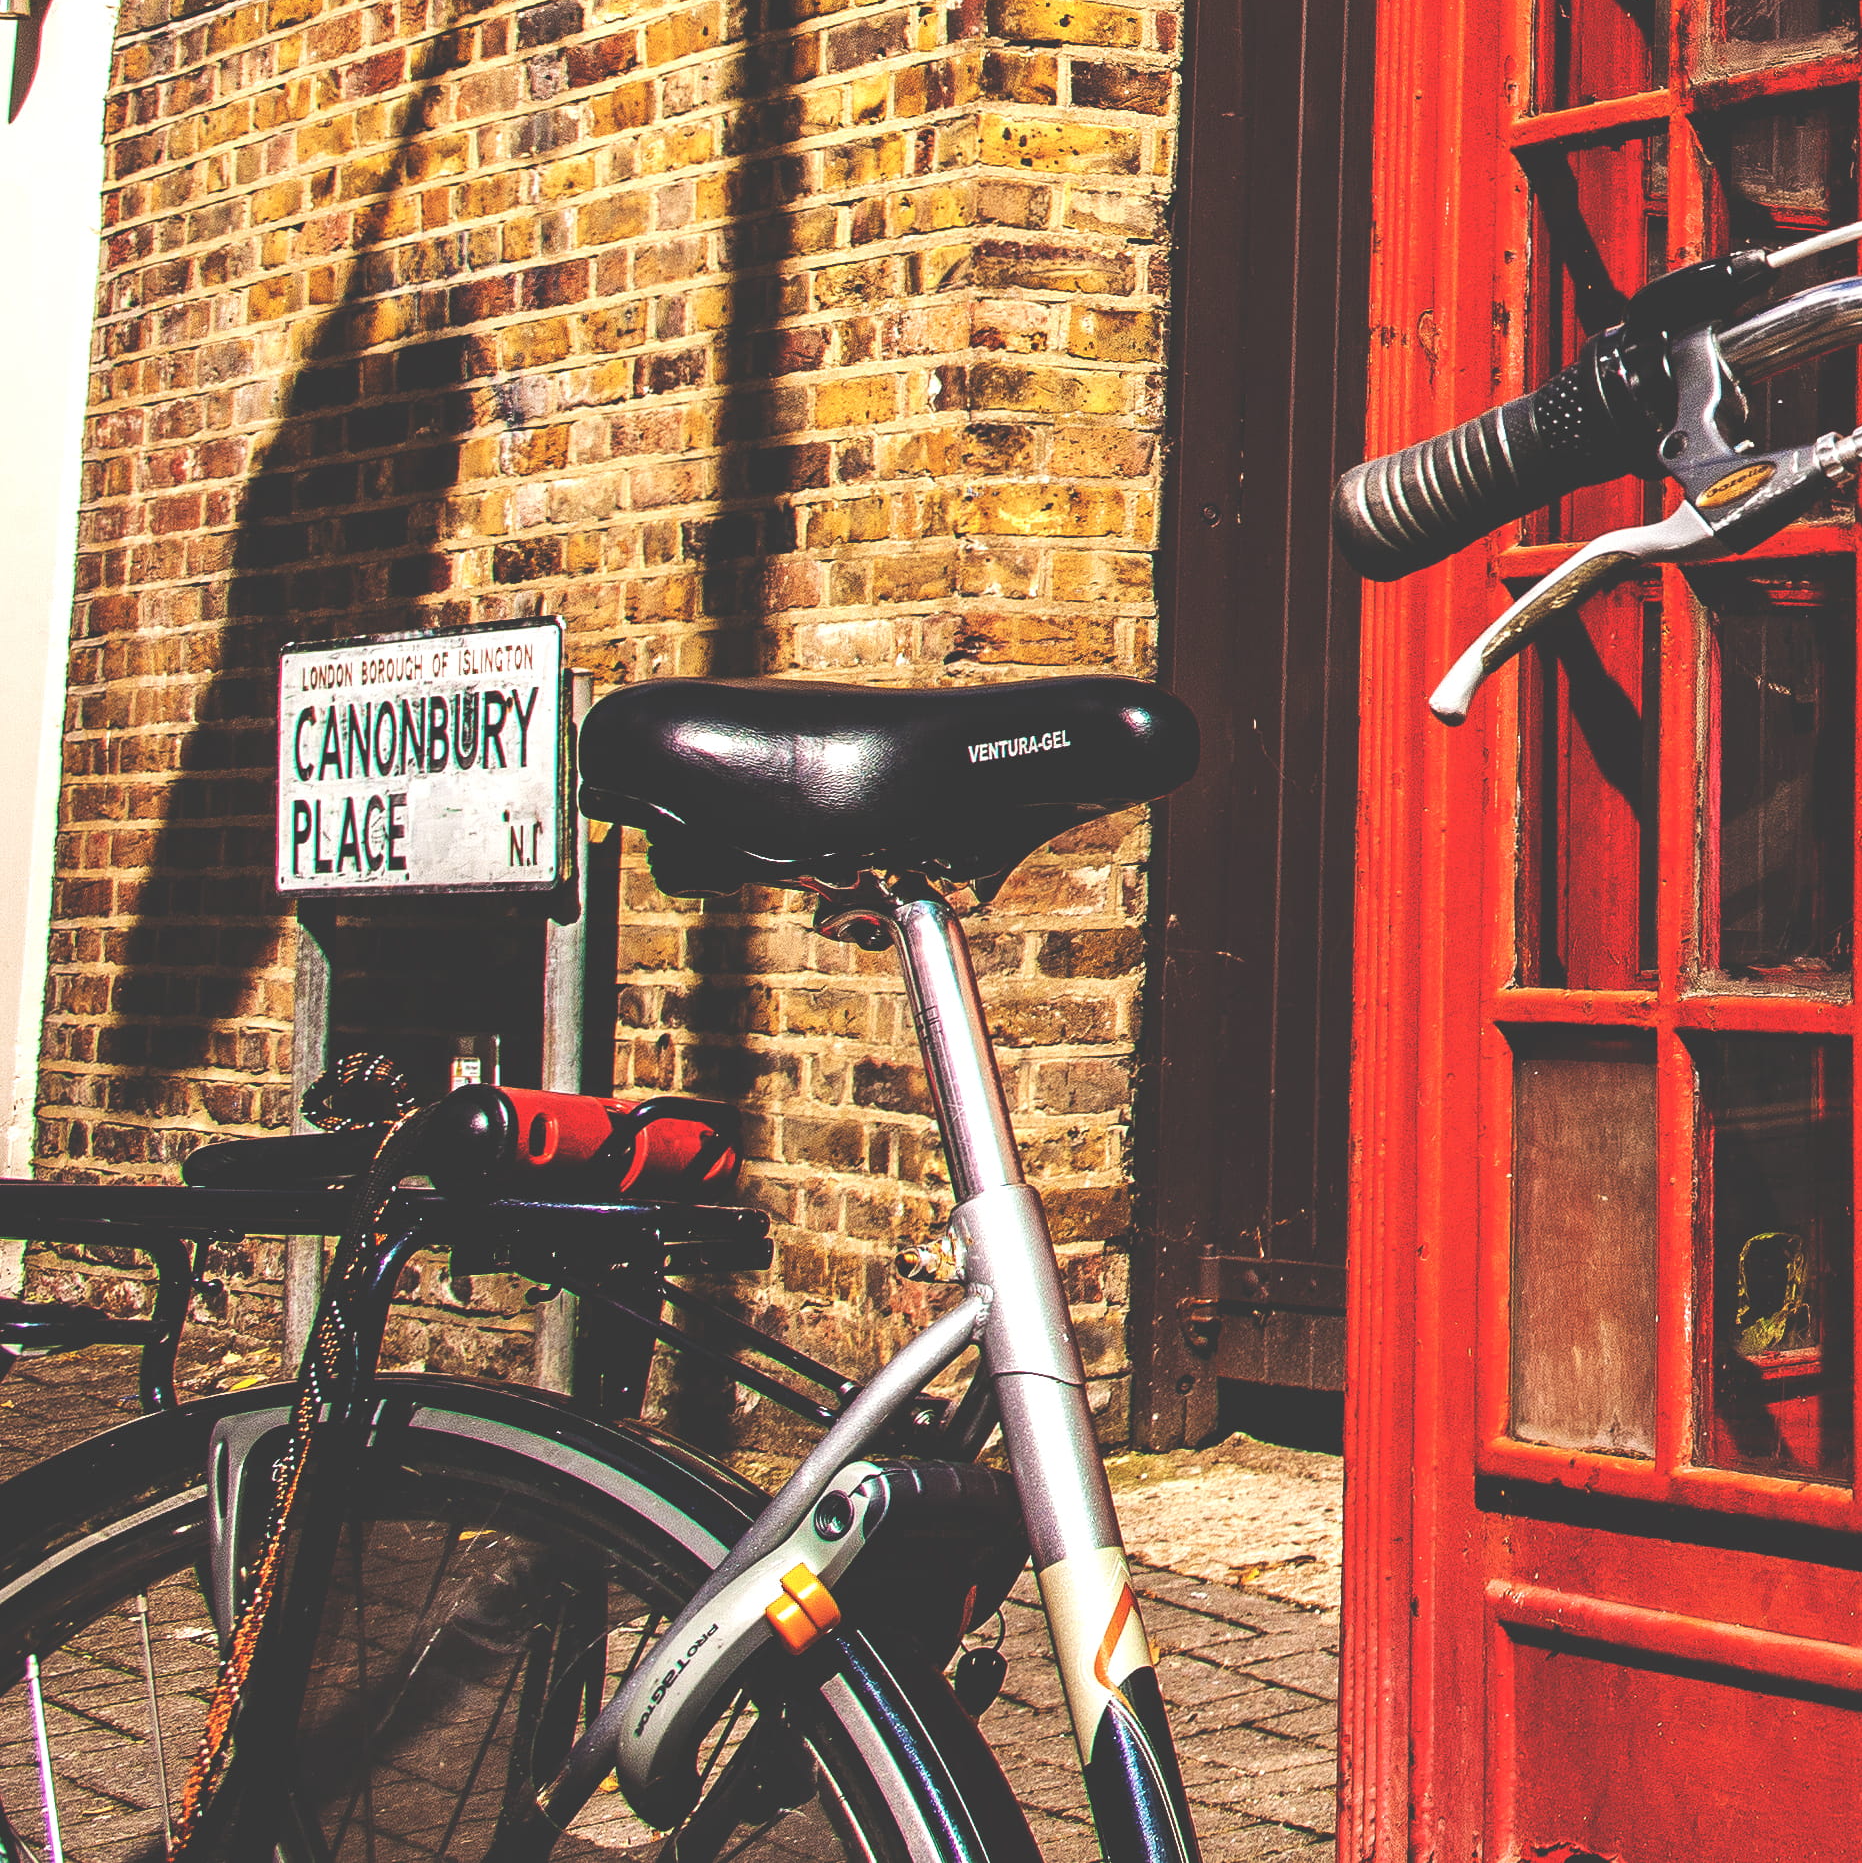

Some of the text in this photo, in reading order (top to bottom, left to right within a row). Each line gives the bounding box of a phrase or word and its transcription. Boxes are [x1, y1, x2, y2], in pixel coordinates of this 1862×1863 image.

[302, 643, 534, 692] LONDON BOROUGH OF ISLINGTON
[294, 686, 539, 782] CANONBURY
[968, 730, 1071, 764] VENTURA-GEL
[292, 792, 408, 876] PLACE
